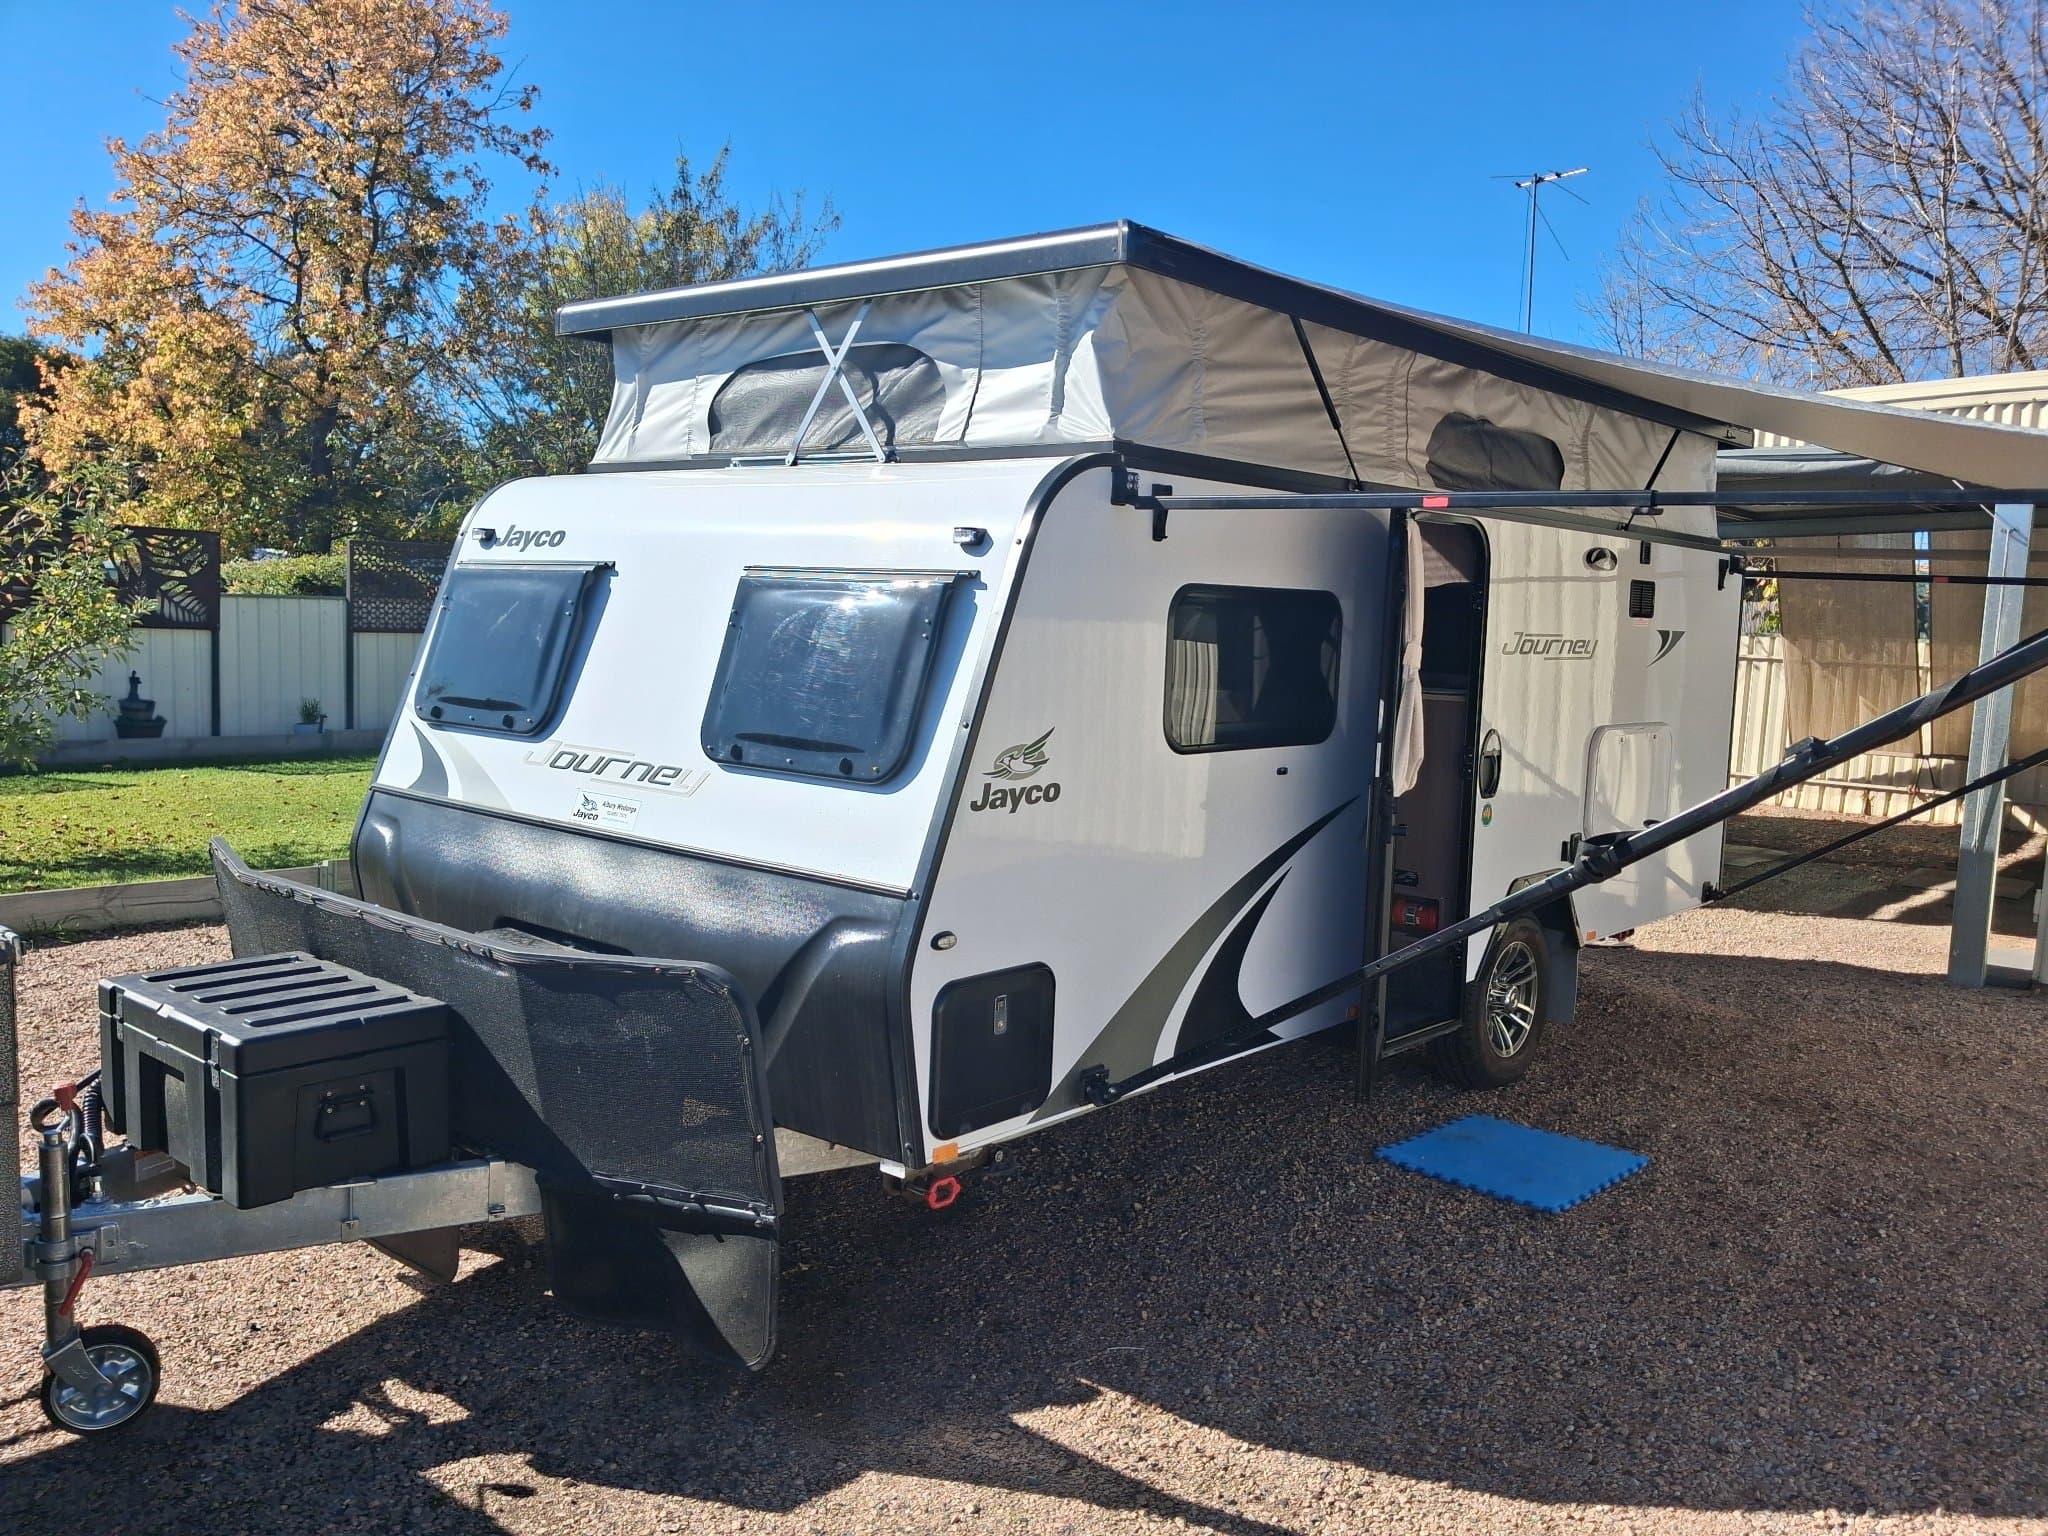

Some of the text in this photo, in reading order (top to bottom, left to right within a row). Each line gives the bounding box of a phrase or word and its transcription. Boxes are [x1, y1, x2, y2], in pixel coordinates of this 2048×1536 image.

[495, 524, 566, 552] Jayco
[1502, 632, 1599, 660] Journey
[970, 782, 1061, 814] Jayco
[573, 809, 599, 821] Jayco
